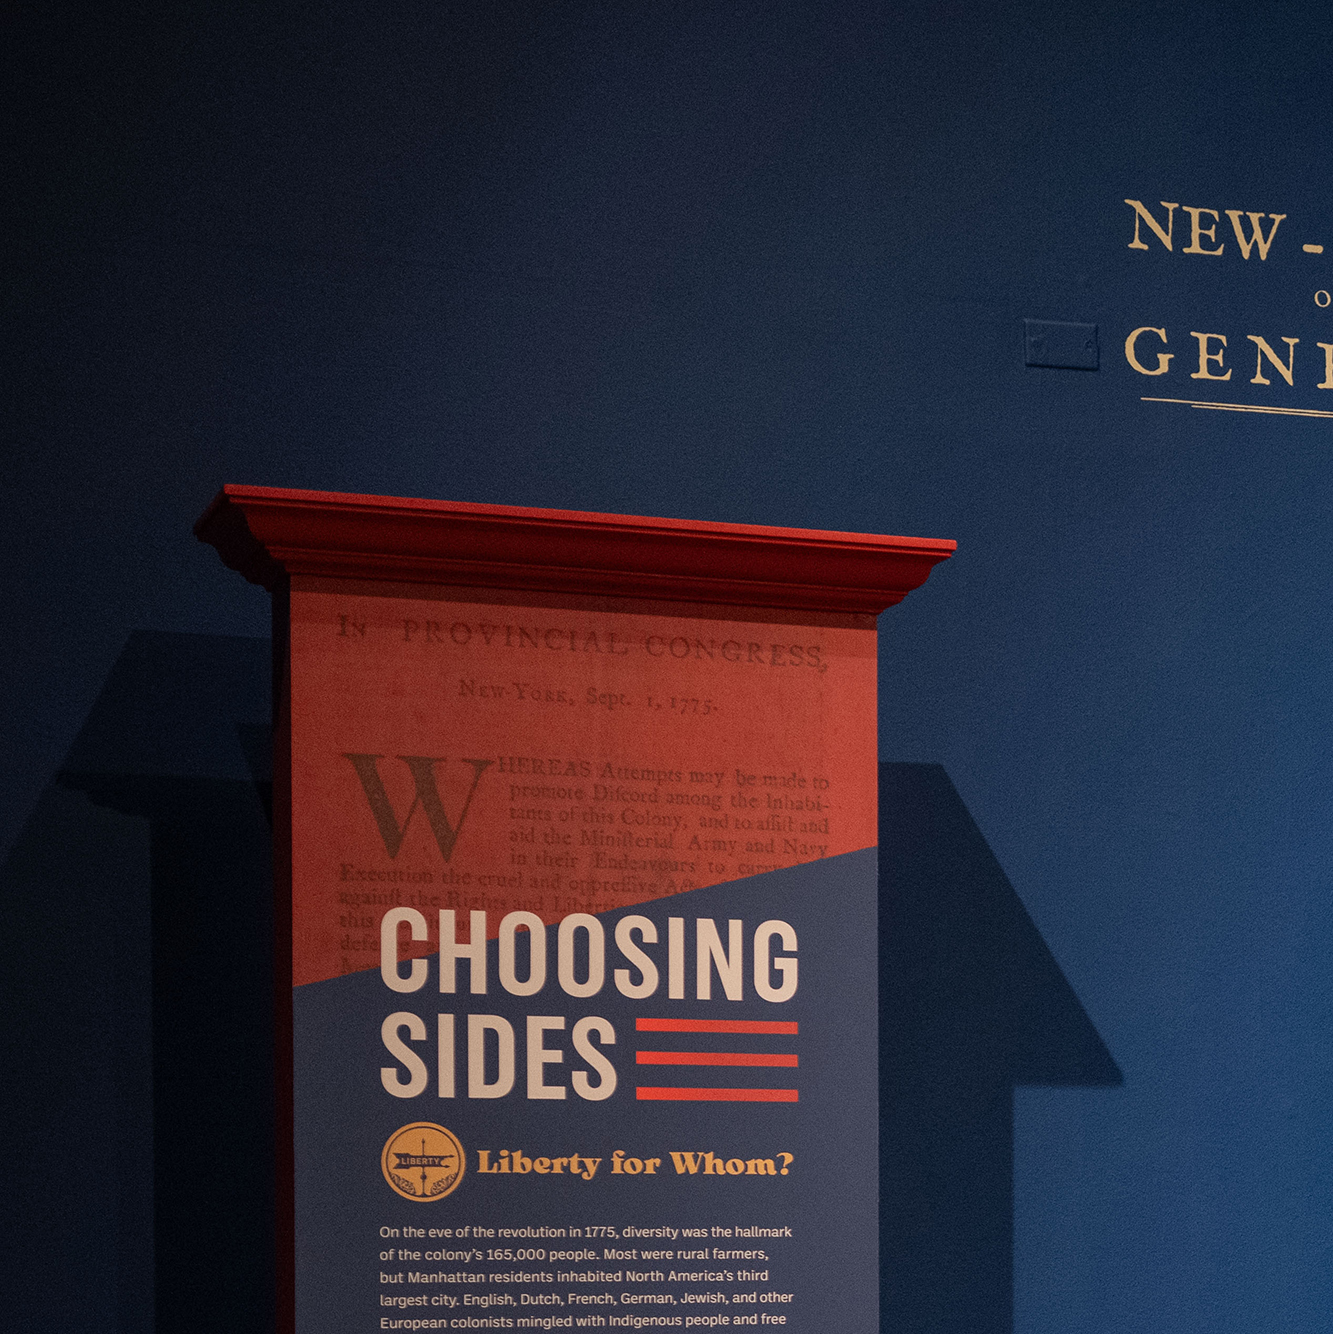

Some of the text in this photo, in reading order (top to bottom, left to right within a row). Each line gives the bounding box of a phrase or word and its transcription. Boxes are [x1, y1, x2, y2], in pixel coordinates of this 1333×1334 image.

[1123, 199, 1287, 260] NEW
[402, 619, 628, 655] PROVINCIAL
[645, 635, 828, 673] CONGRESS,
[586, 686, 632, 710] Sept.
[689, 770, 726, 788] may
[735, 769, 756, 786] be
[763, 771, 807, 790] made
[813, 774, 830, 790] to
[380, 905, 800, 1003] CHOOSING
[380, 1010, 618, 1102] SIDES
[399, 1155, 441, 1168] LIBERTY
[476, 1149, 795, 1180] Liberty for Whom?
[378, 1225, 793, 1240] On the eve of the revolution in 1775, diversity was the hallmark
[378, 1246, 770, 1263] of the colony's 165,000 people. Most were rural farmers,
[379, 1268, 769, 1284] but Manhattan residents inhabited North America's third
